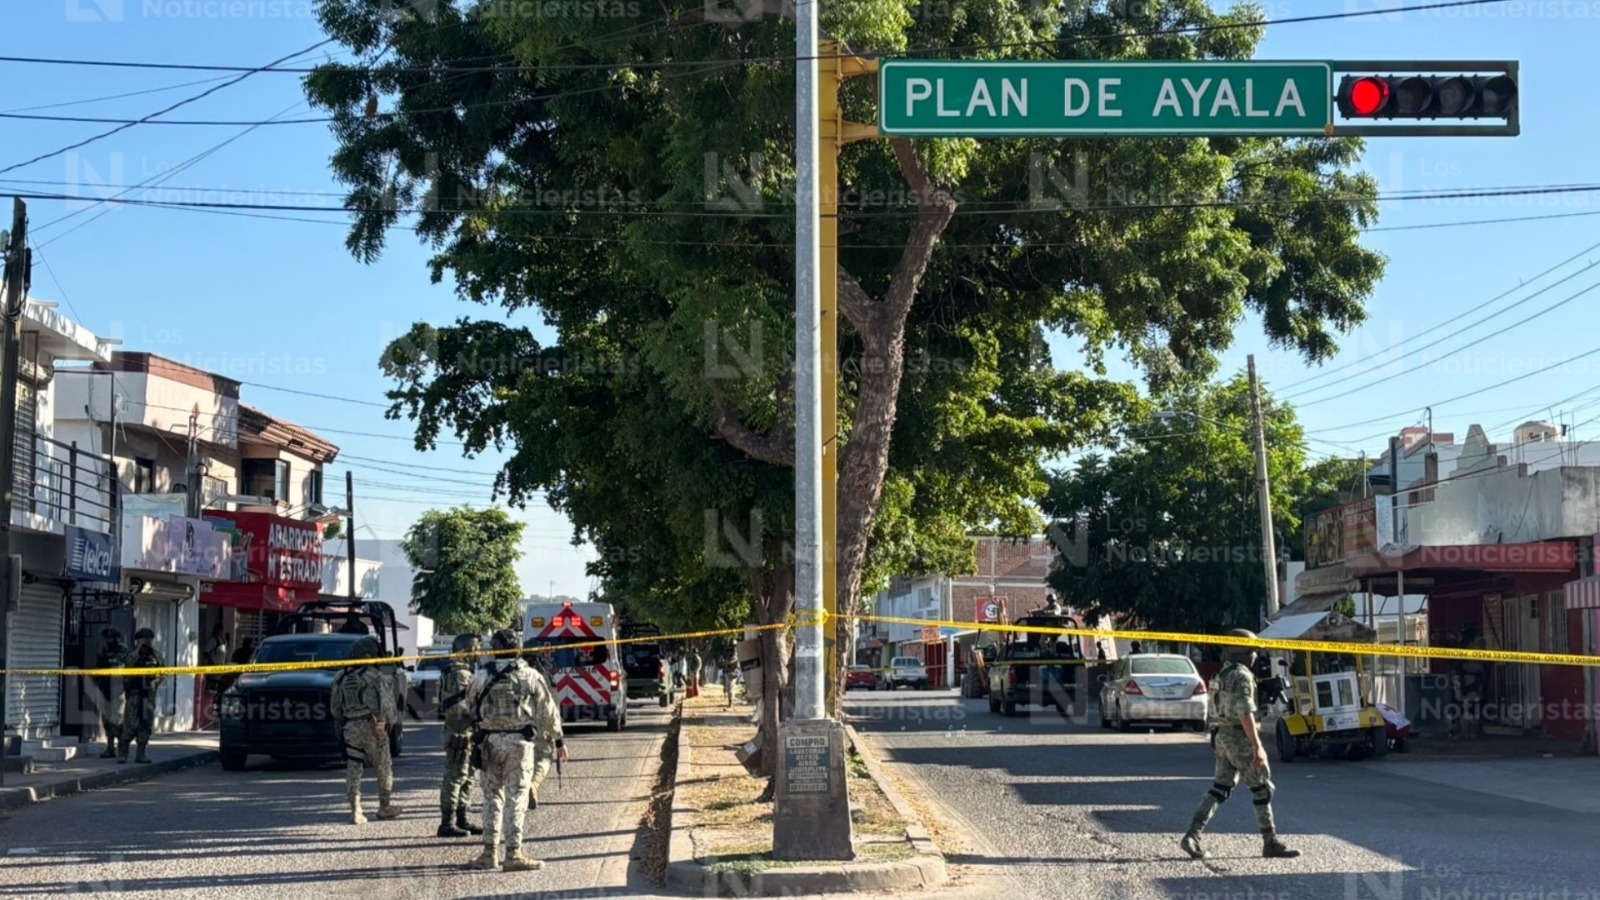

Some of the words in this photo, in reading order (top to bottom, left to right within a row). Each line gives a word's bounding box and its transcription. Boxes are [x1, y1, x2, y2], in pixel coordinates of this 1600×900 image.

[905, 78, 1028, 117] PLAN
[1064, 78, 1122, 117] DE
[1152, 78, 1306, 117] AYALA
[82, 540, 113, 577] telcel
[790, 738, 825, 747] COMPRO
